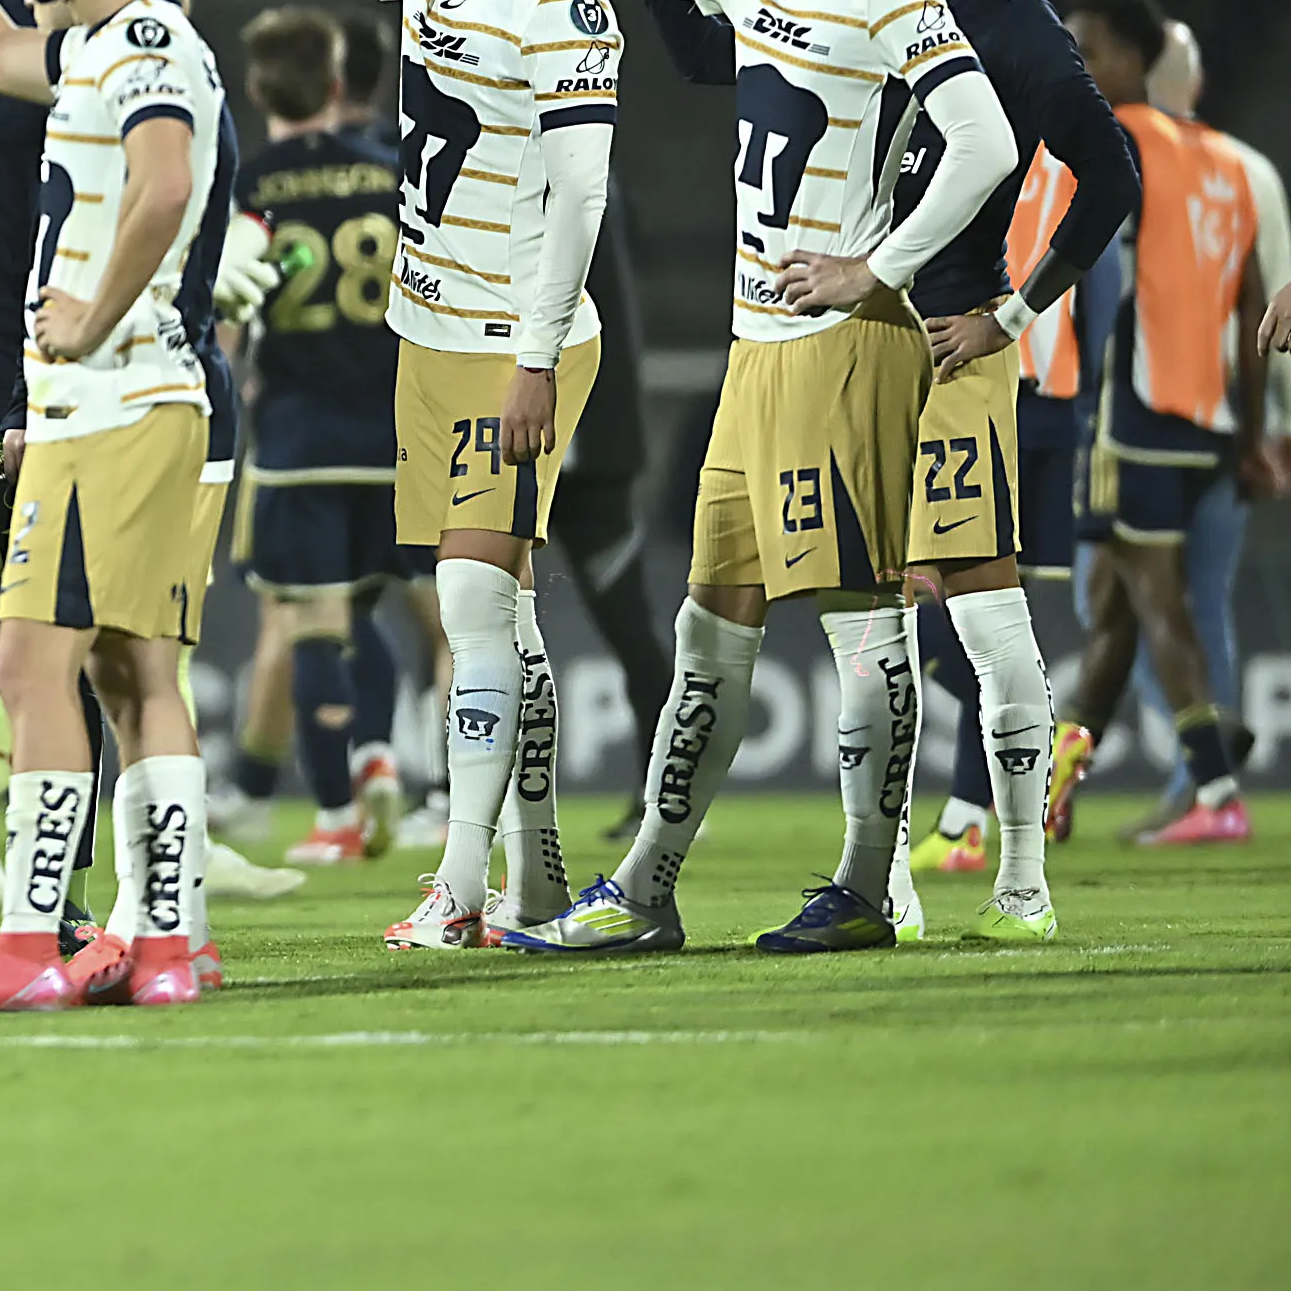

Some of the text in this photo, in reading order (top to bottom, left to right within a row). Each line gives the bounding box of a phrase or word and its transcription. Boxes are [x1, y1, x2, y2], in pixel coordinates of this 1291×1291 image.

[753, 8, 814, 51] DHL
[271, 212, 398, 333] 28
[449, 417, 501, 478] 29
[779, 467, 825, 534] 23
[920, 436, 982, 503] 22
[518, 647, 559, 802] CREST
[657, 671, 723, 825] CREST
[877, 656, 917, 818] CREST
[27, 780, 80, 913] CRES
[147, 803, 187, 931] CRES
